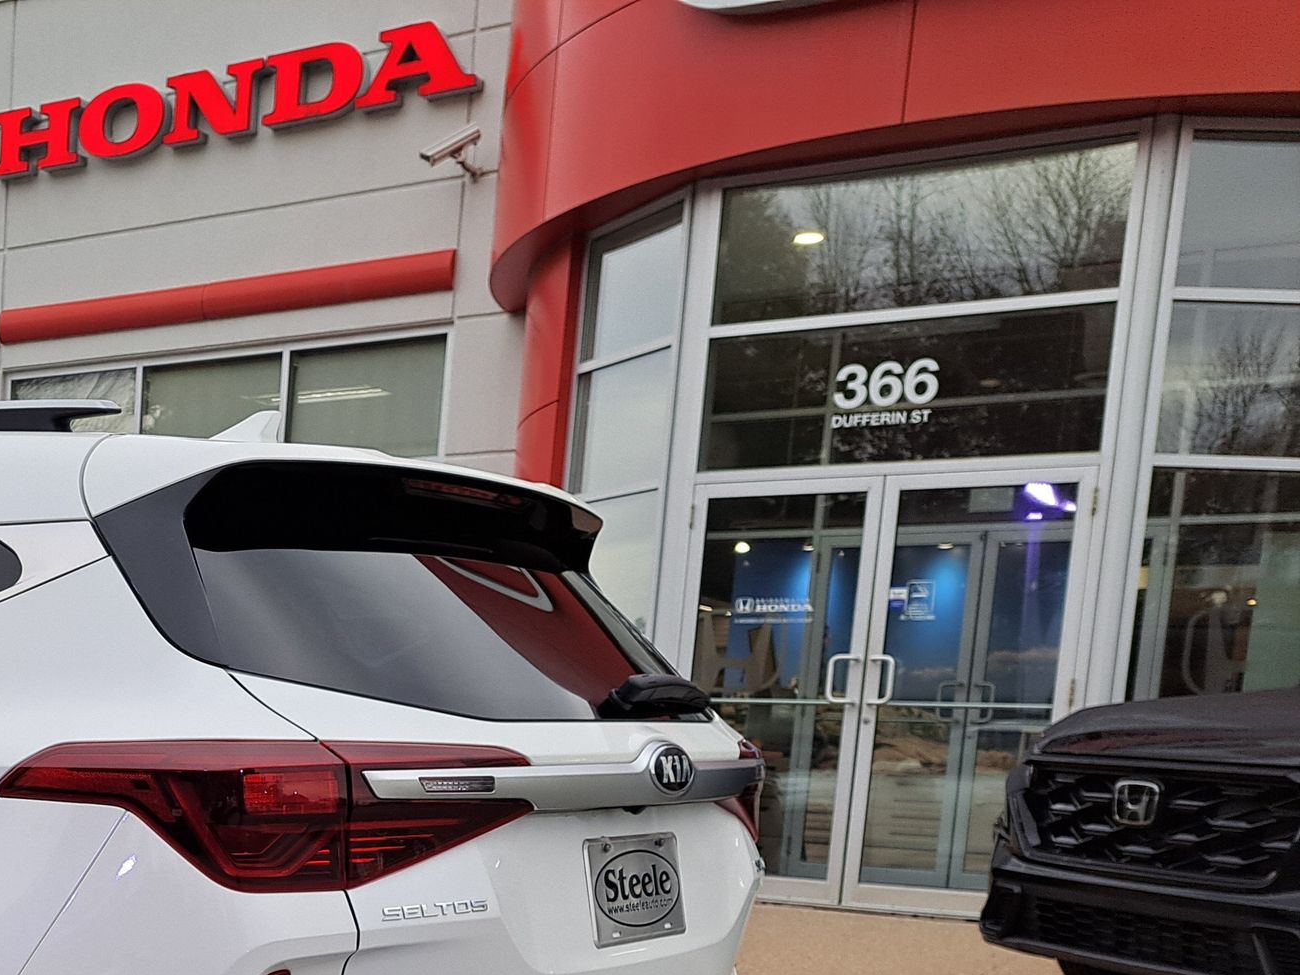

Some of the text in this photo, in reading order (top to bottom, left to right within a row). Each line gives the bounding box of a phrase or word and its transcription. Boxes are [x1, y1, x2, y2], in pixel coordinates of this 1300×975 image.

[833, 357, 940, 409] 366
[830, 408, 932, 429] DUFFERIN ST
[755, 604, 813, 613] HONDA
[660, 754, 691, 783] KIA
[603, 864, 673, 902] Steele
[382, 899, 488, 921] SELTOS
